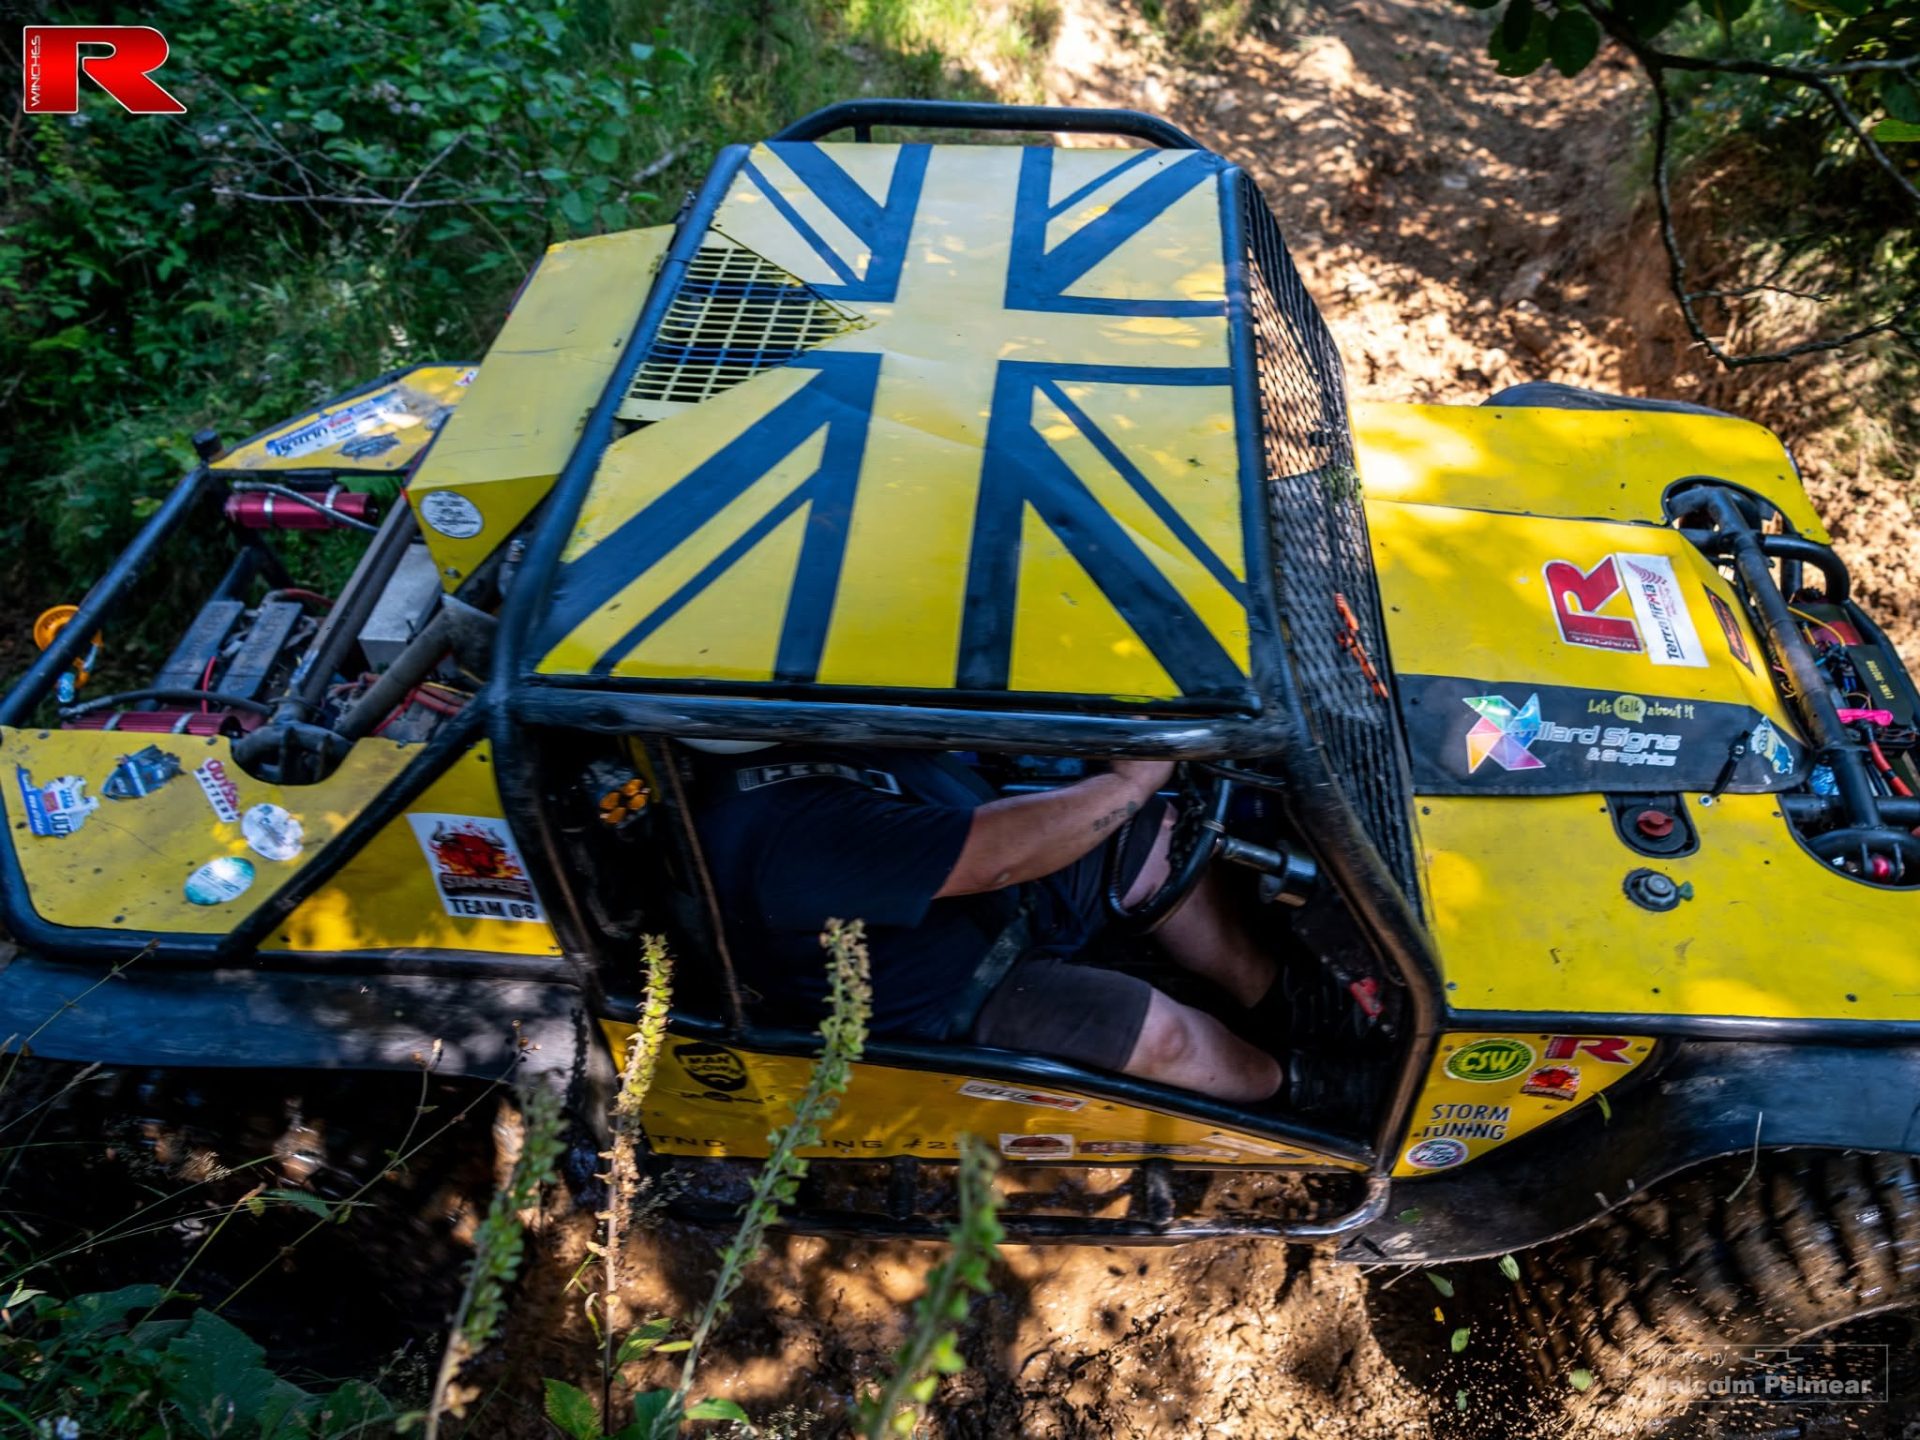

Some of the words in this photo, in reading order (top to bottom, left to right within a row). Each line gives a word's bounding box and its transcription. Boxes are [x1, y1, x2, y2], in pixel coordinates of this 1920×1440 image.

[1542, 554, 1645, 654] R
[1619, 700, 1641, 713] talk
[1646, 702, 1682, 719] about
[1601, 727, 1682, 753] Signs
[1585, 747, 1600, 761] &
[1600, 750, 1677, 767] Graphics
[197, 768, 236, 821] BATTERY
[447, 898, 508, 917] TEAM
[508, 903, 538, 919] 08
[1457, 1050, 1520, 1072] CSW
[1431, 1104, 1512, 1122] STORM
[650, 1134, 726, 1147] TND
